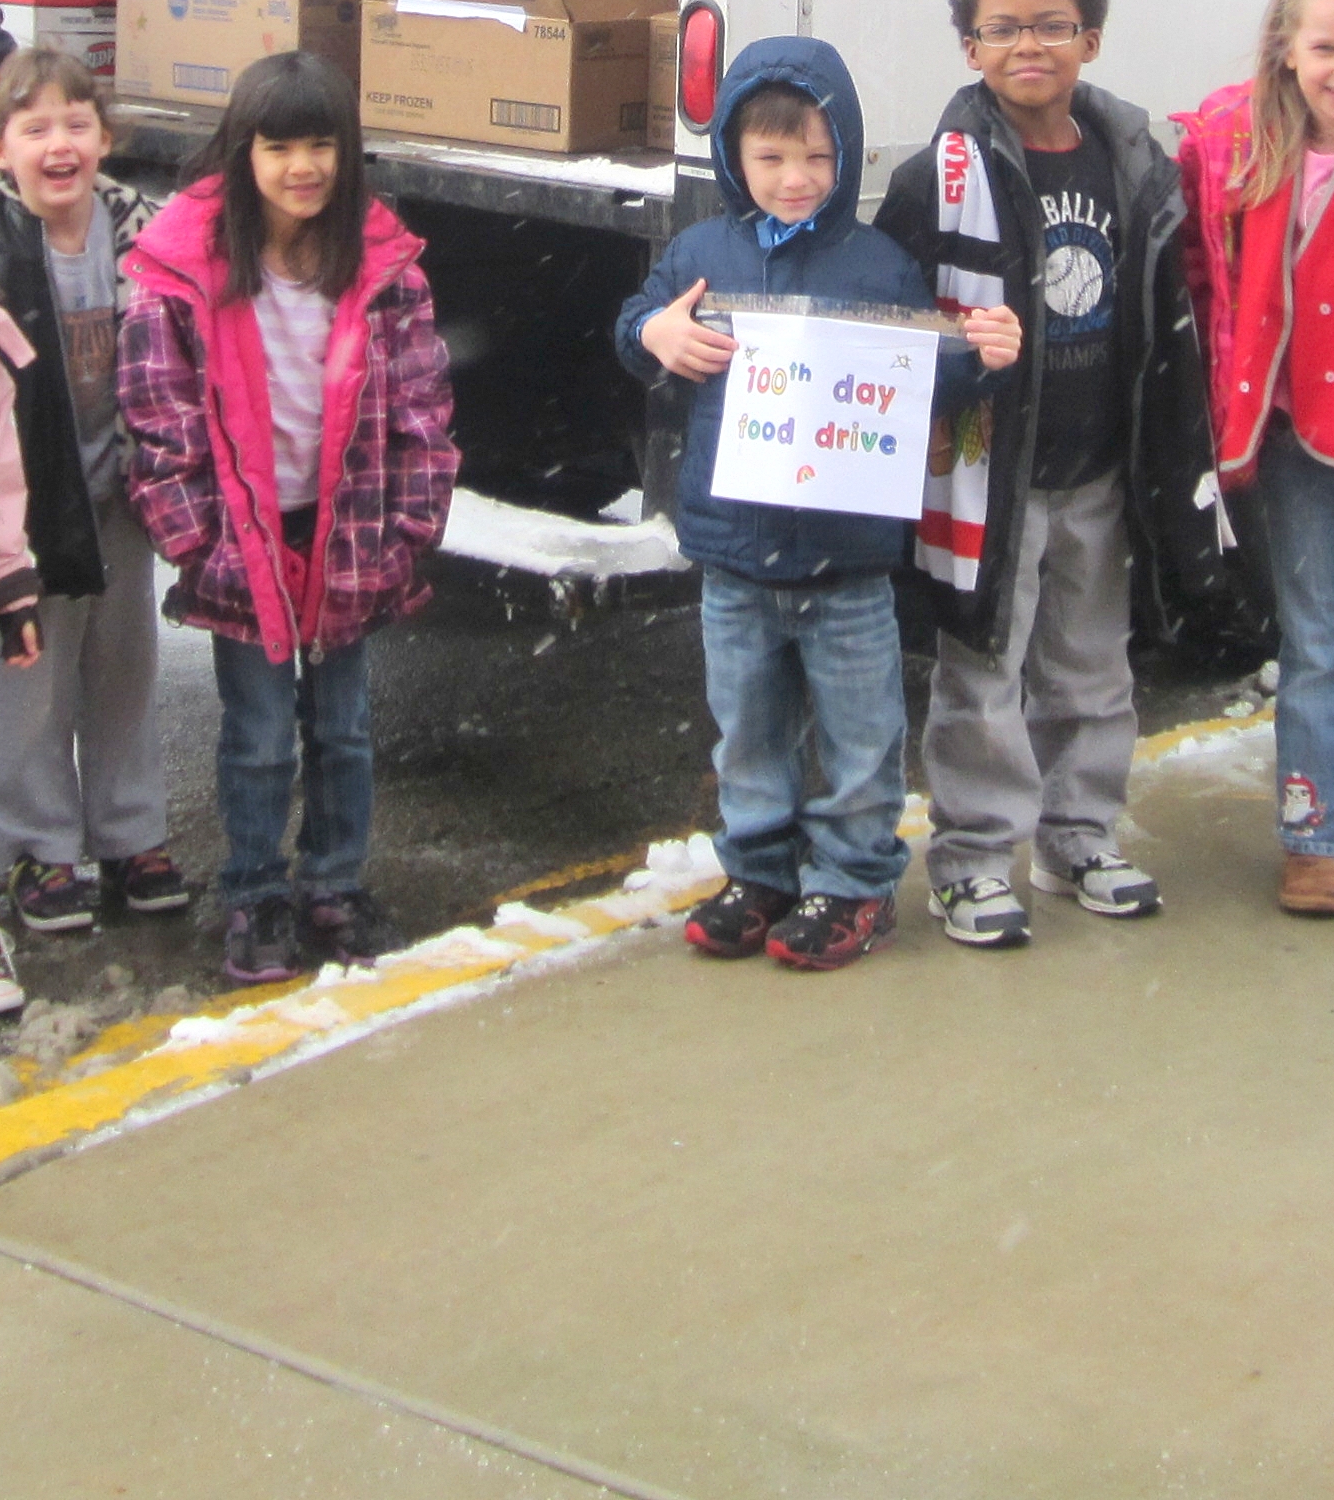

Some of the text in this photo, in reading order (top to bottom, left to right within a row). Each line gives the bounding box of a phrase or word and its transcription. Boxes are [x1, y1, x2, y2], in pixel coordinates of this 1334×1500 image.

[533, 24, 566, 41] 78544
[366, 91, 434, 110] KEEP FROZEN
[746, 361, 897, 415] 100th day
[737, 412, 898, 457] food drive
